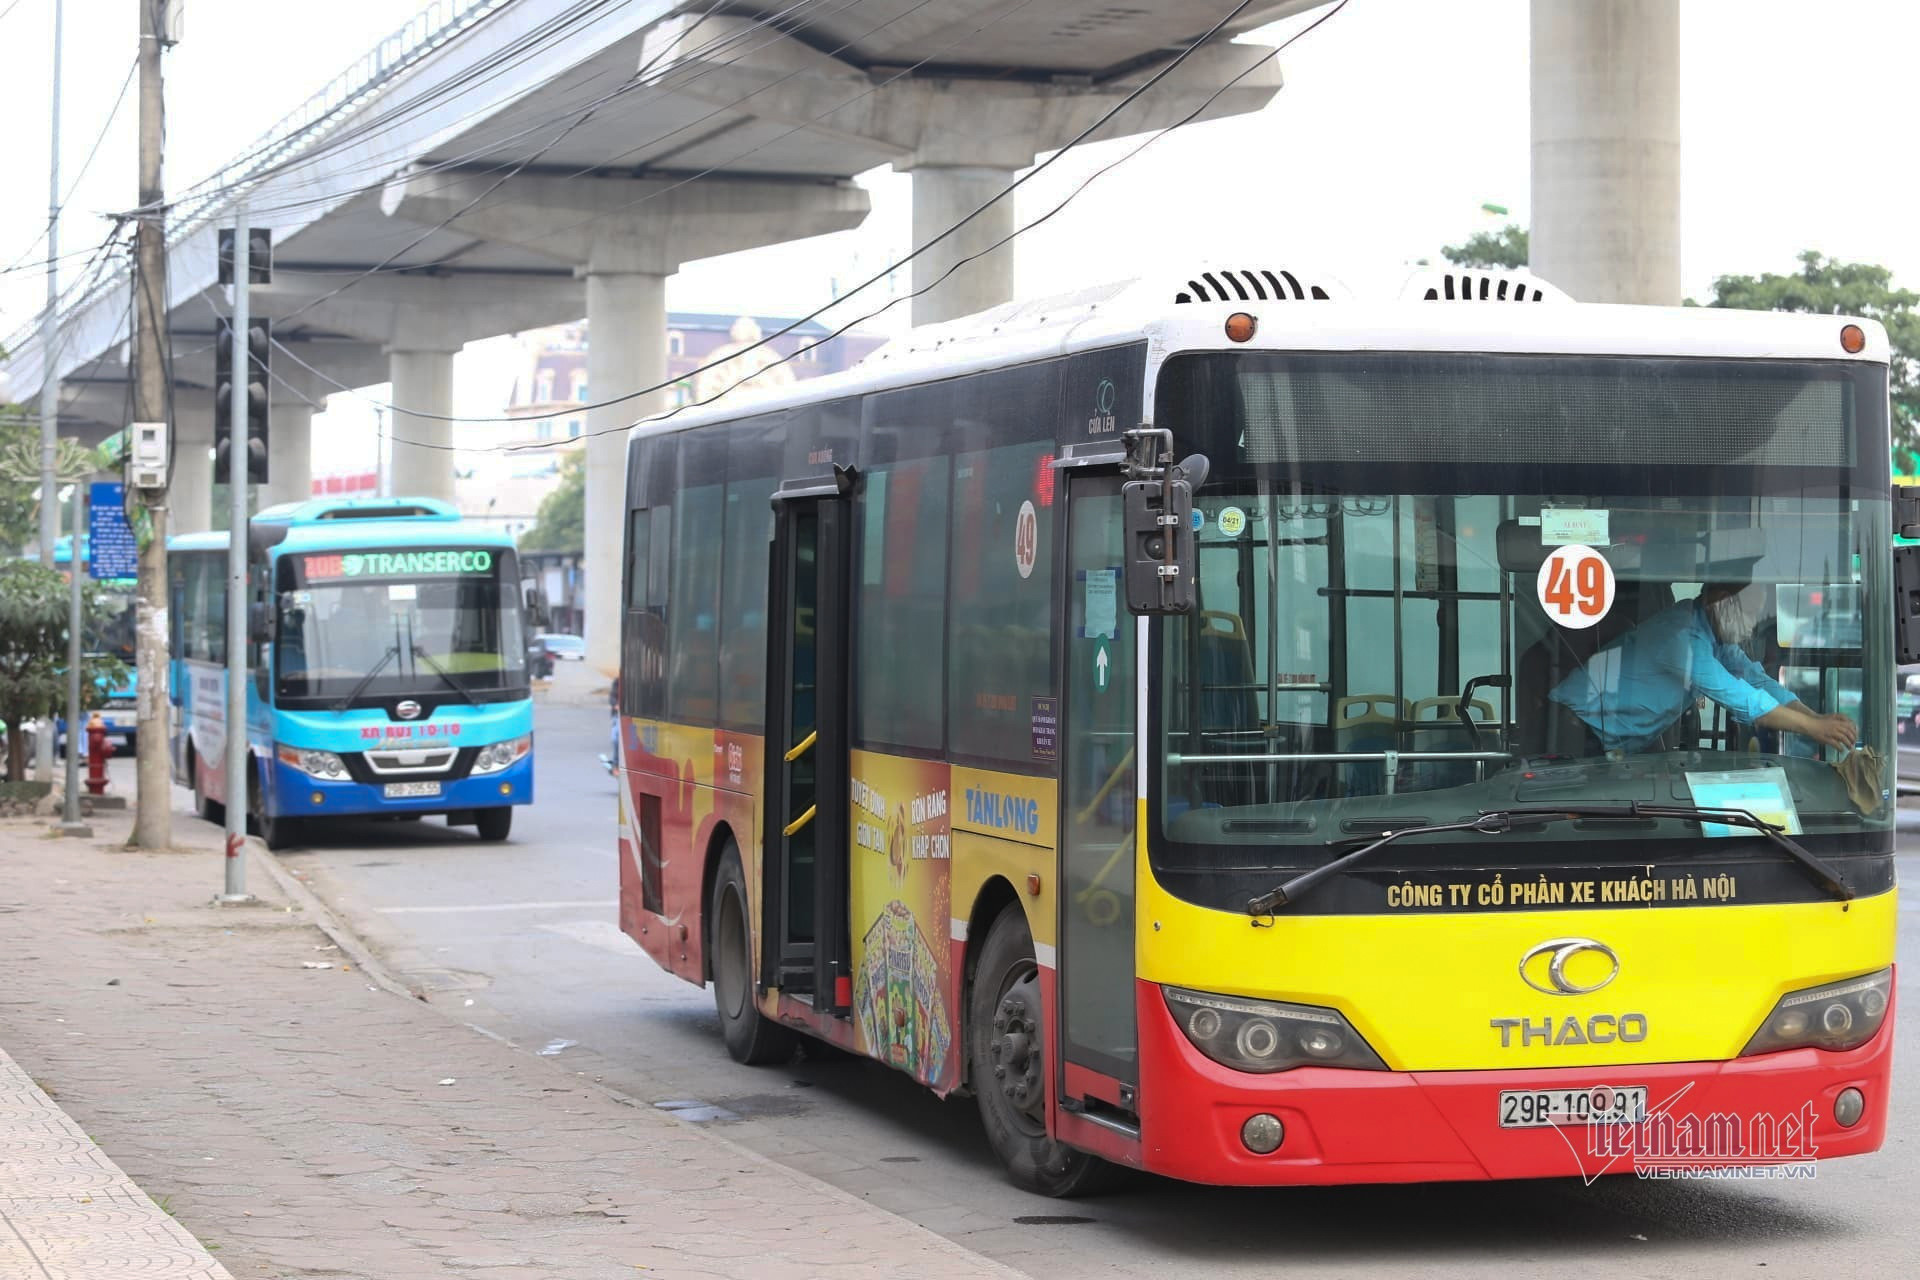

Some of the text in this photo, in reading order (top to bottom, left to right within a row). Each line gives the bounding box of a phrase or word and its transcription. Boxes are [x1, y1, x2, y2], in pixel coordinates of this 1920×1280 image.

[1017, 513, 1035, 566] 49
[363, 551, 492, 574] TRANSERCO
[1544, 556, 1605, 616] 49
[1387, 872, 1737, 908] CÔNG TY CỔ PHẦN XE KHÁCH HÀ NỘI
[1490, 1012, 1648, 1048] THACO
[1503, 1090, 1641, 1125] 29B-109.91
